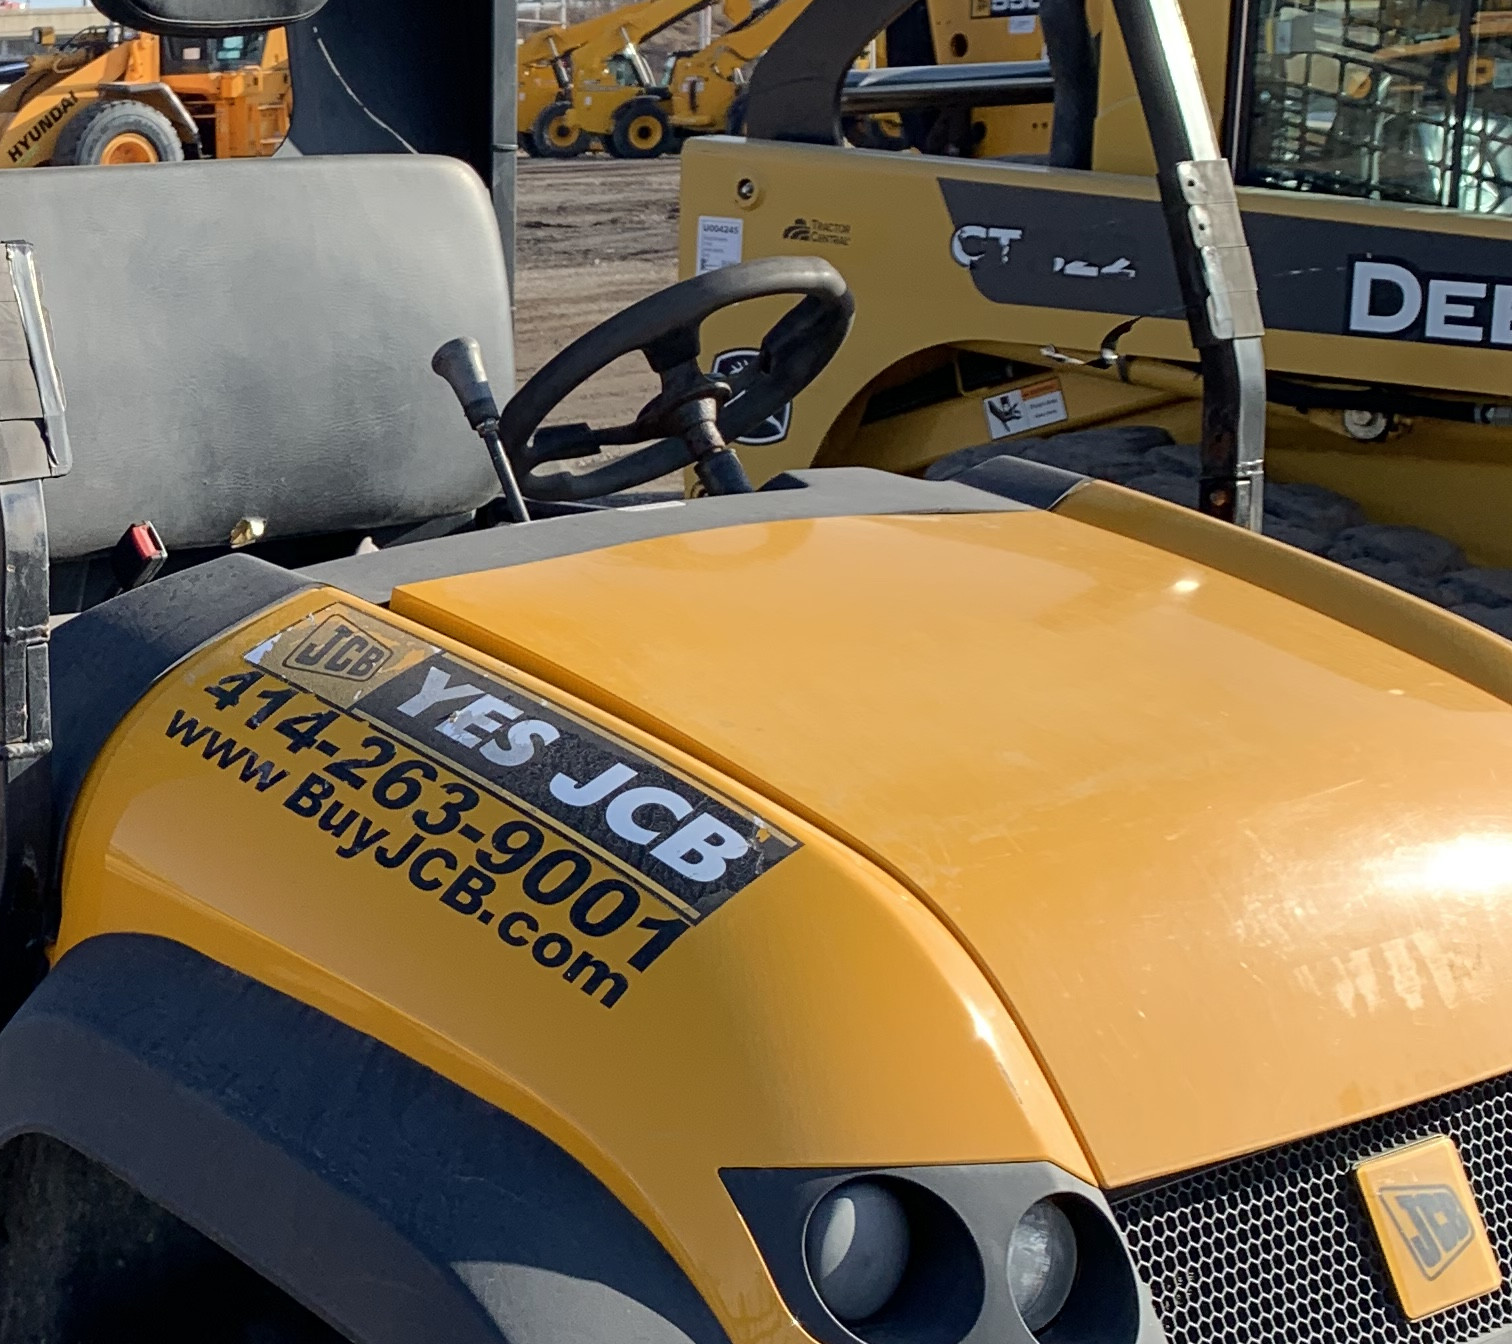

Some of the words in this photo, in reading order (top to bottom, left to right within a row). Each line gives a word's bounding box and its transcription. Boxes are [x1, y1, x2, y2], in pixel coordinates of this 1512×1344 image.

[7, 90, 80, 163] HYUNDAI
[951, 225, 1023, 268] CT
[294, 624, 385, 677] JCB
[396, 665, 560, 769] YES
[549, 762, 748, 883] JCB
[204, 669, 690, 973] 414-263-9001
